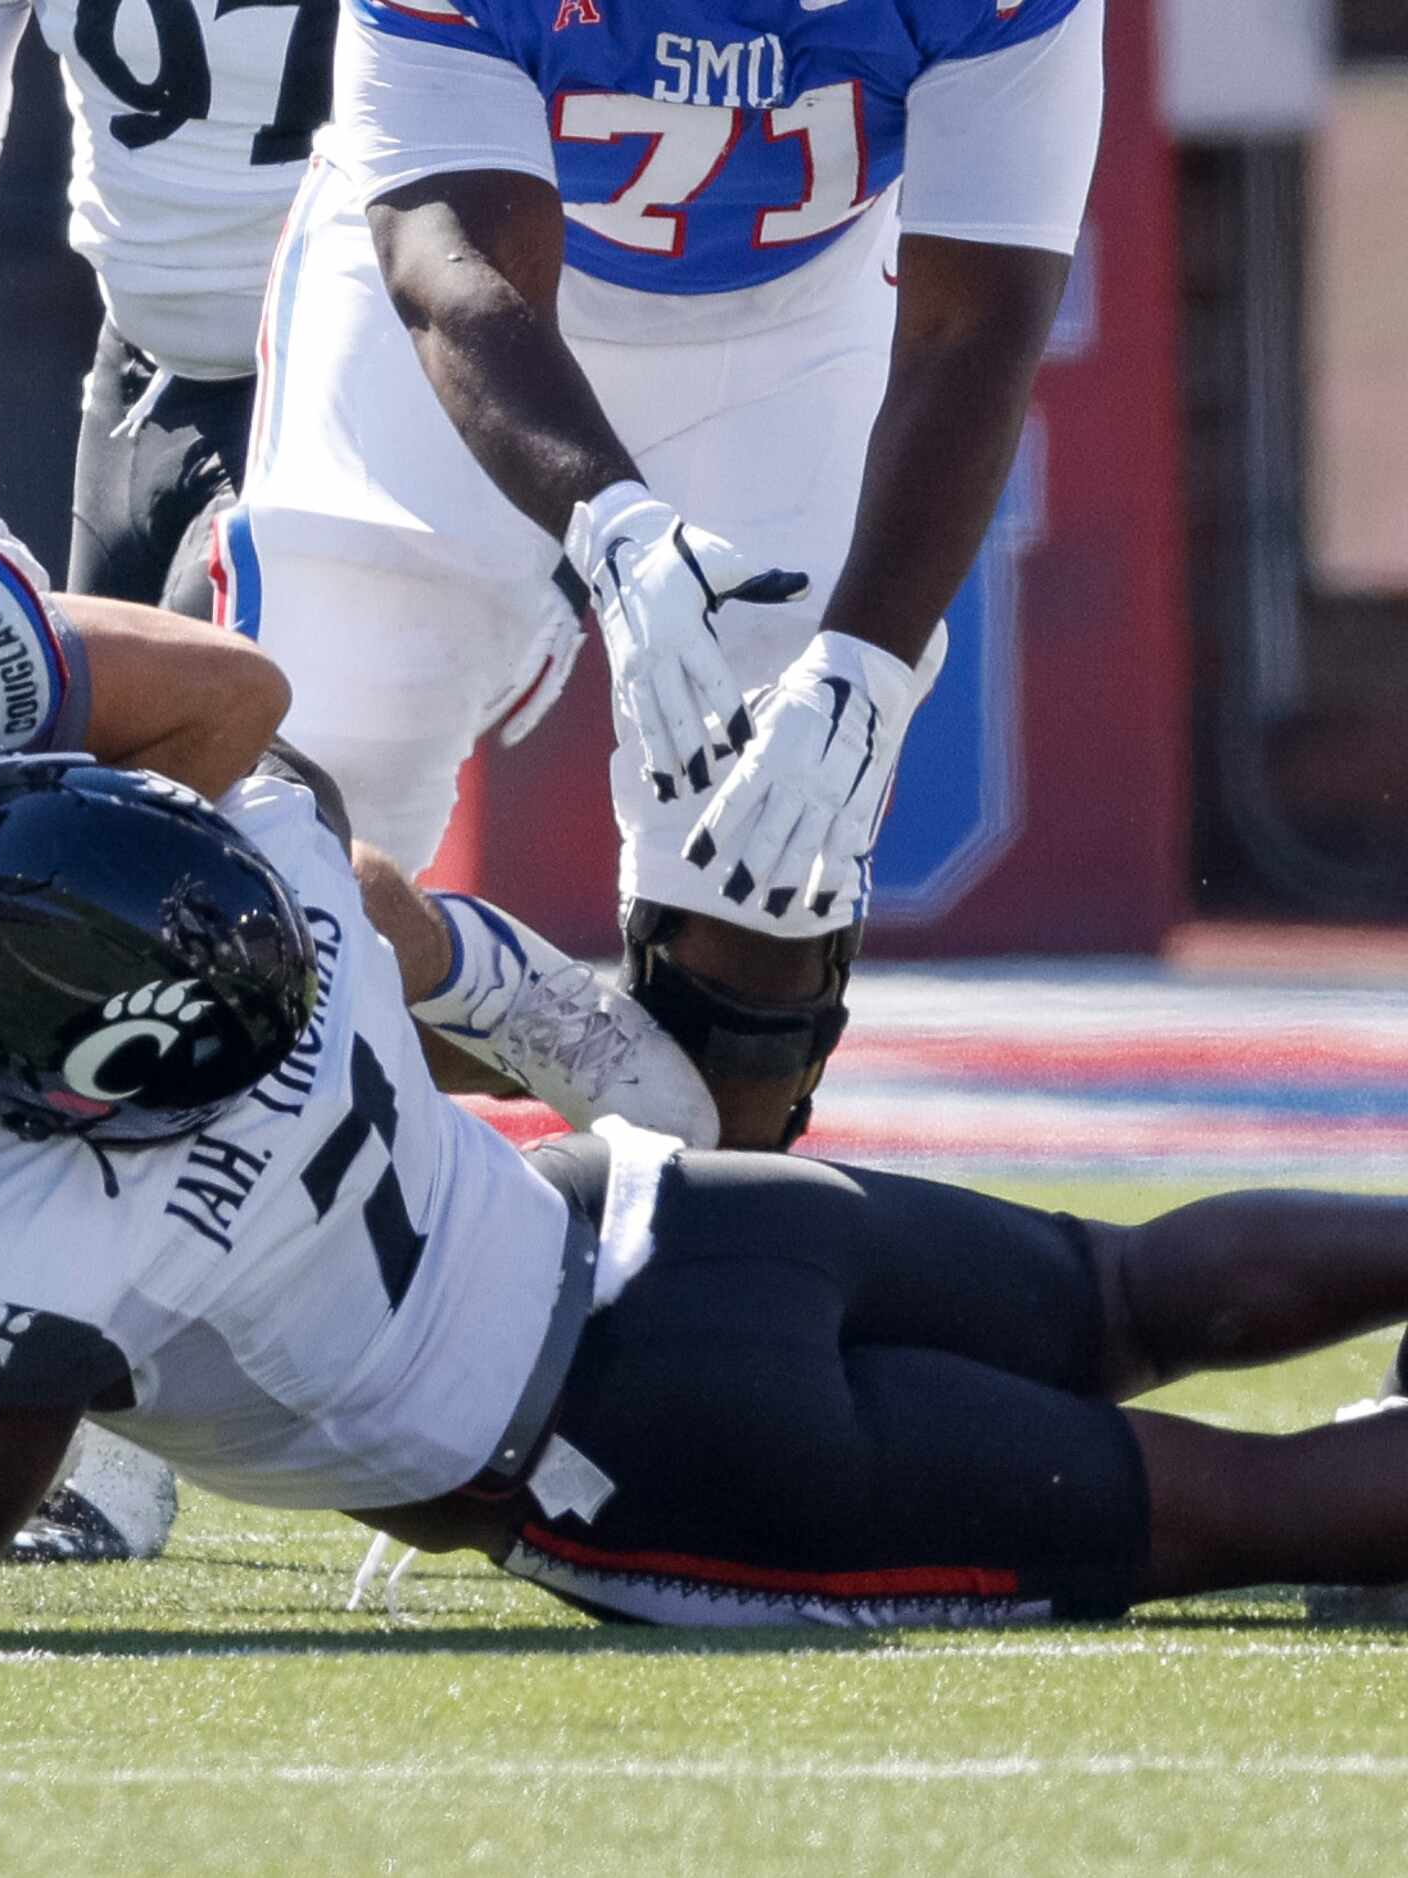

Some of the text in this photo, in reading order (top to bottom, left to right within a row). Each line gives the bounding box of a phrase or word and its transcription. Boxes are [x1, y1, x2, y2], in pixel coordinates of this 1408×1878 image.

[74, 0, 340, 166] 97
[653, 32, 784, 108] SMU
[552, 80, 870, 258] 71
[165, 1136, 272, 1253] JAH.
